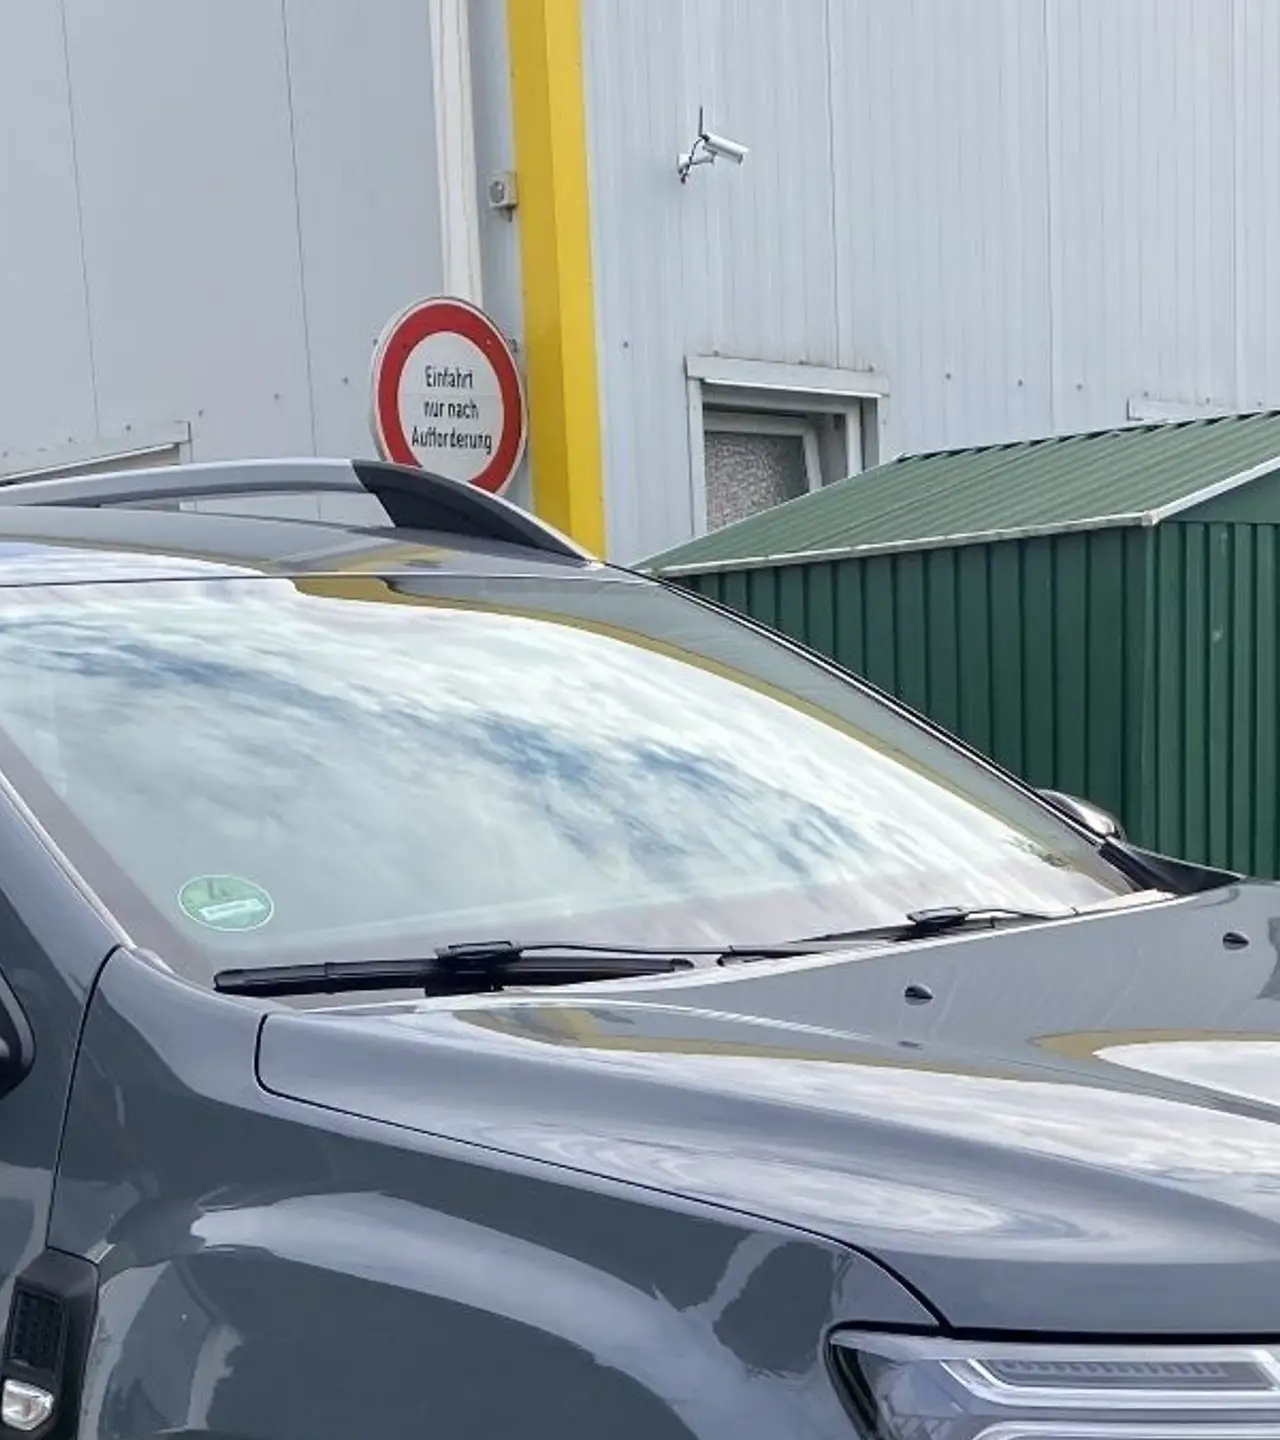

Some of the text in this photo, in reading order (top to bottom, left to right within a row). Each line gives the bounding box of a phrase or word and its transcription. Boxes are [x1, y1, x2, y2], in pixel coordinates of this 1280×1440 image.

[425, 366, 474, 389] Einfahrt
[423, 399, 479, 420] nur nach
[411, 426, 493, 455] Aufforderung
